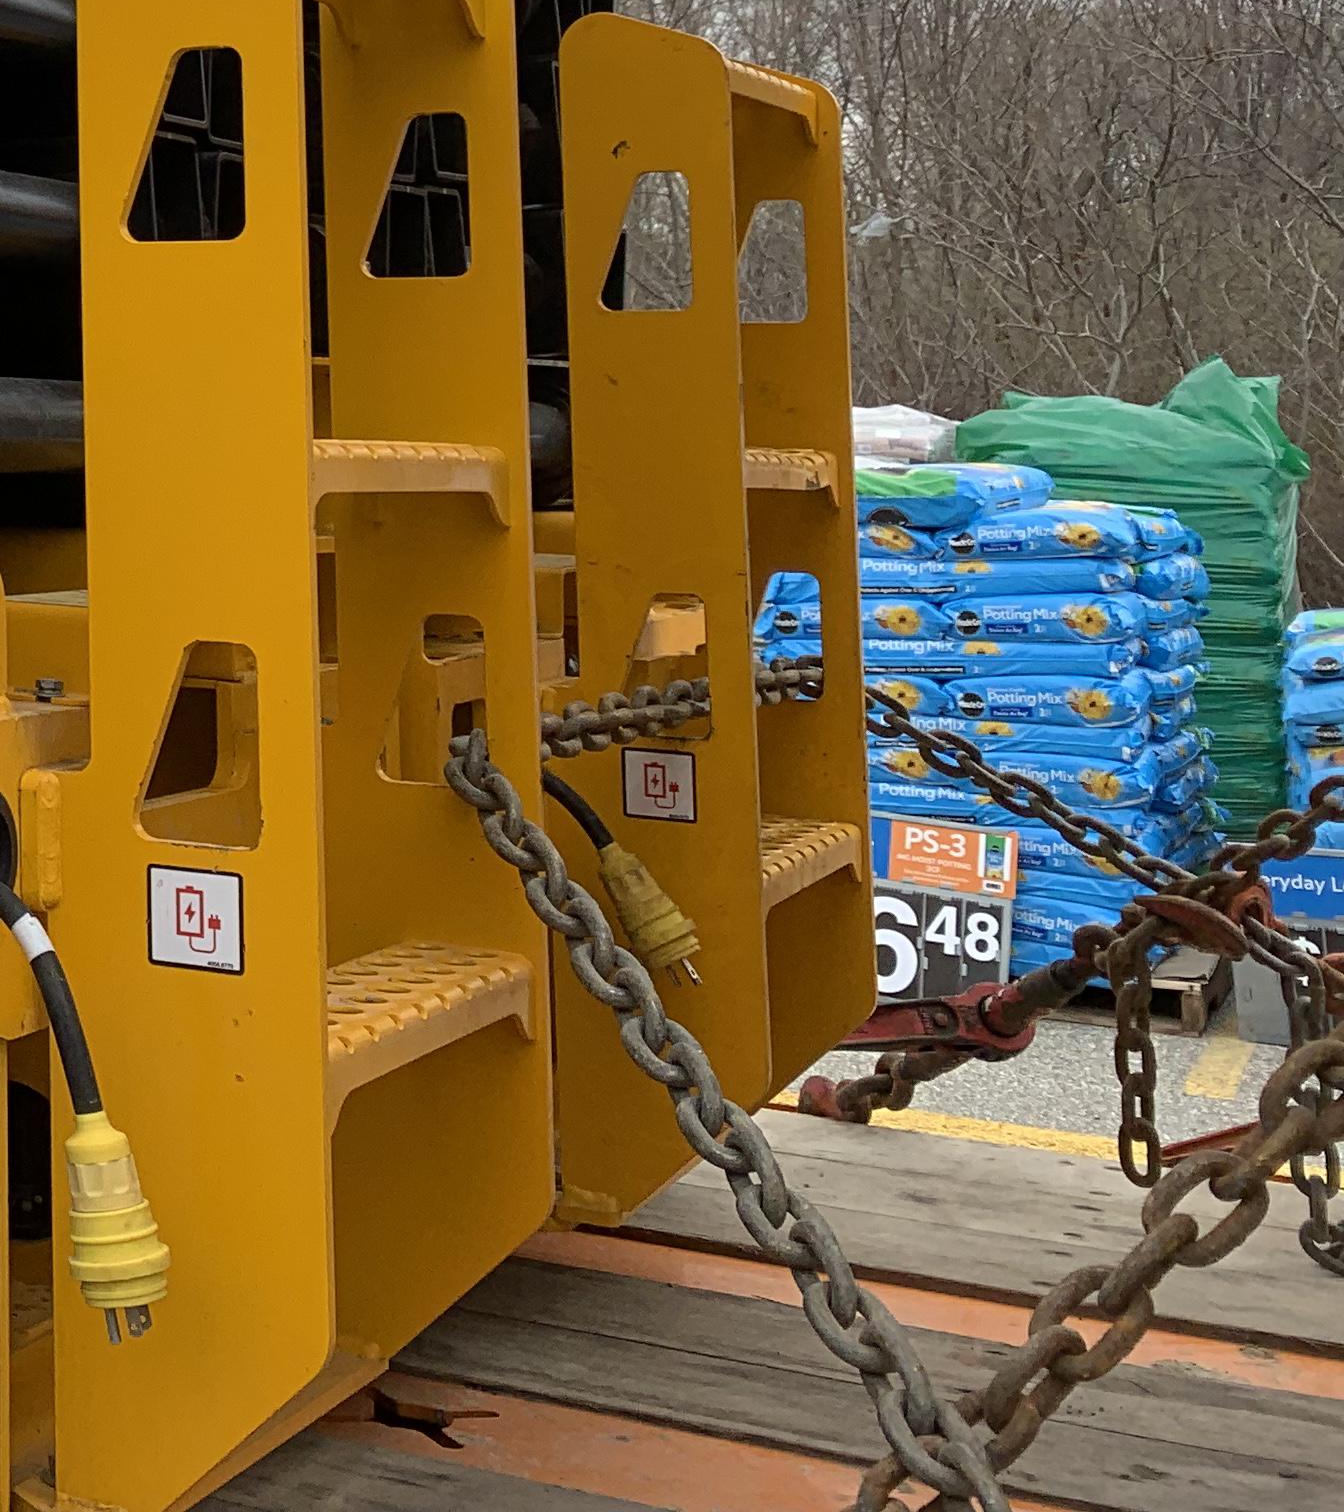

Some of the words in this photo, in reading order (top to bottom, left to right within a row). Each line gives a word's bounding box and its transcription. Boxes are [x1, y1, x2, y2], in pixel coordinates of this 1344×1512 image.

[862, 559, 919, 576] Potting
[983, 607, 1032, 624] Potting
[1033, 607, 1058, 620] Mix
[868, 639, 926, 654] Potting
[987, 691, 1037, 707] Potting
[1037, 692, 1064, 704] Mix
[879, 783, 935, 801] Potting
[904, 826, 967, 858] PS-3
[1023, 841, 1051, 856] ting
[1260, 874, 1326, 896] eryday
[1331, 876, 1344, 893] L
[1014, 910, 1055, 930] otting
